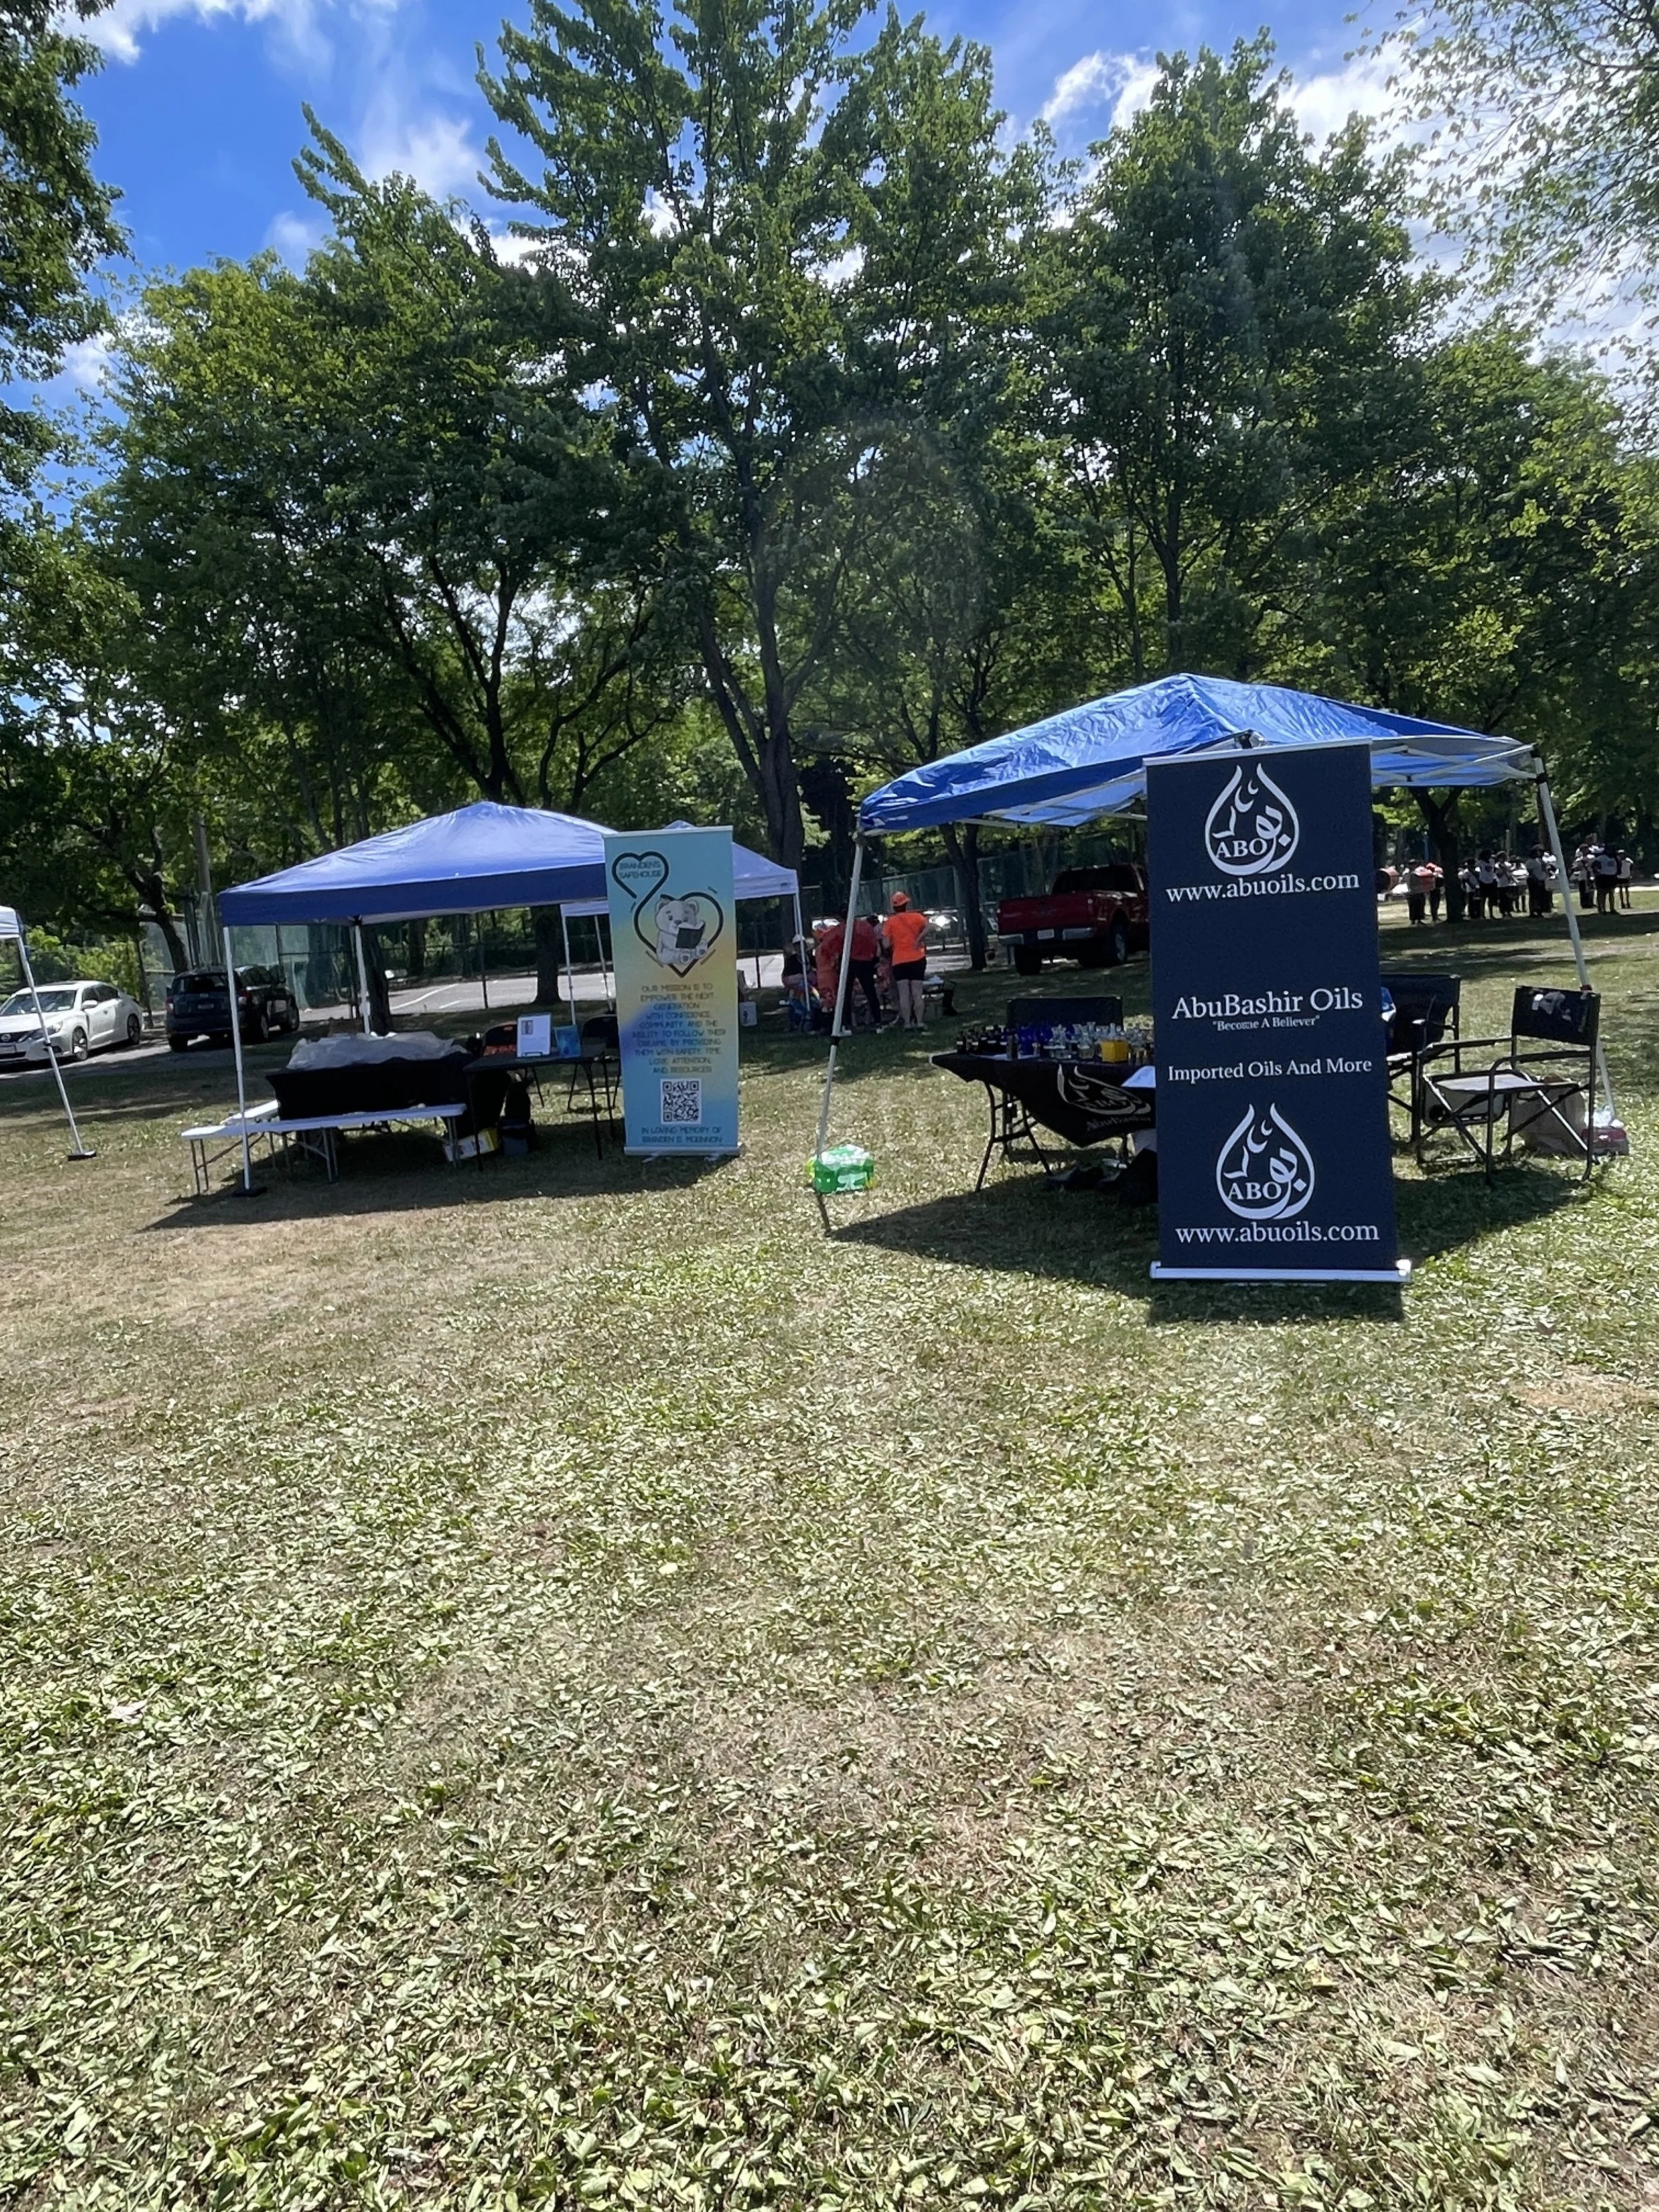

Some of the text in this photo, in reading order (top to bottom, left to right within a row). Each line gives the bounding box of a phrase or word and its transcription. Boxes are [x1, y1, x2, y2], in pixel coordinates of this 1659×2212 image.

[1216, 838, 1268, 859] ABO
[1165, 873, 1360, 903] www.abuoils.com
[703, 982, 713, 991] TO
[640, 993, 677, 1002] EMPOWER
[696, 992, 715, 1000] NEXT
[653, 1001, 700, 1011] GENERATION
[1171, 986, 1364, 1019] AbuBashir Oils
[705, 1019, 719, 1027] THE
[1212, 1015, 1321, 1032] "Become A Believer"
[632, 1030, 659, 1039] ABILITY
[1168, 1057, 1373, 1084] Imported Oils And More
[1228, 1181, 1282, 1201] ABO
[1175, 1220, 1380, 1244] www.abuoils.com
